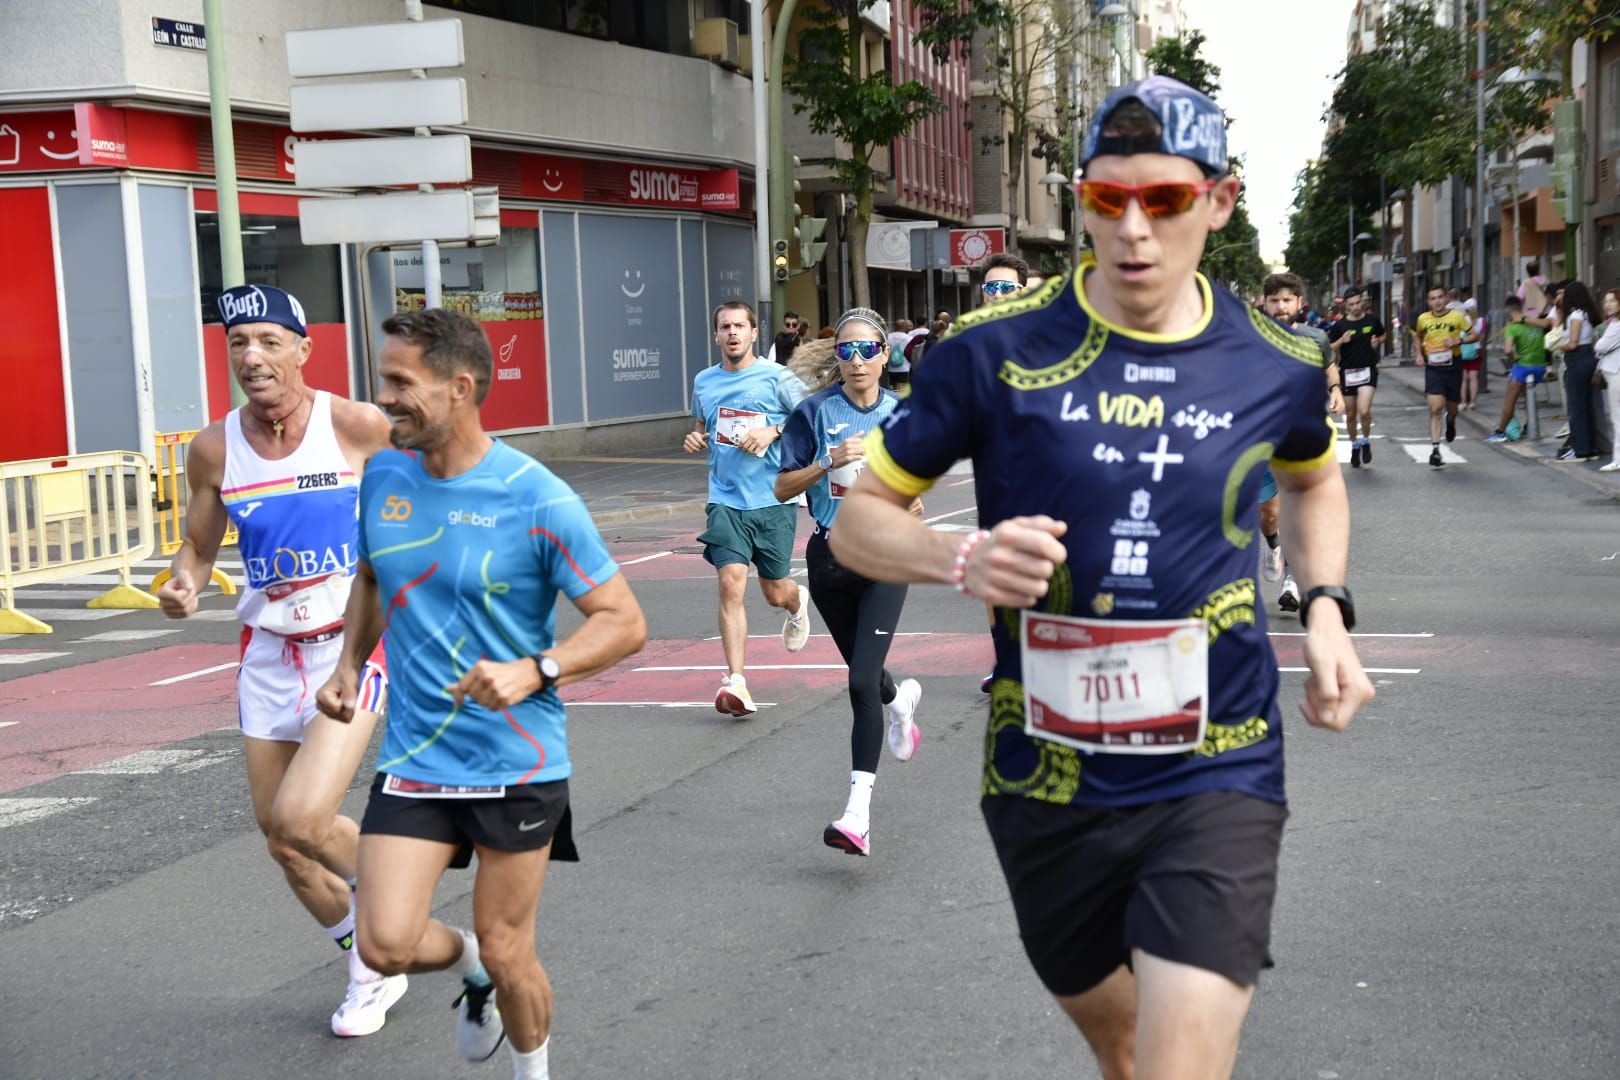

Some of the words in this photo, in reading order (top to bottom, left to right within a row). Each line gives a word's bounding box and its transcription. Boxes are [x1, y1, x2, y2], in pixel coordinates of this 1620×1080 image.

[175, 22, 194, 34] CALLE
[153, 29, 169, 45] LEÓN
[171, 32, 178, 46] Y
[180, 34, 207, 49] CASTILLO
[630, 169, 680, 201] suma
[702, 193, 725, 201] suma
[613, 348, 648, 369] suma
[1060, 391, 1090, 421] La
[1098, 391, 1165, 428] VIDA
[1171, 404, 1234, 440] sigue
[1092, 443, 1125, 464] en
[297, 472, 339, 489] 226ERS
[447, 509, 497, 529] global
[247, 543, 358, 582] GLOBAL
[293, 605, 310, 622] 42
[1078, 672, 1141, 704] 7011
